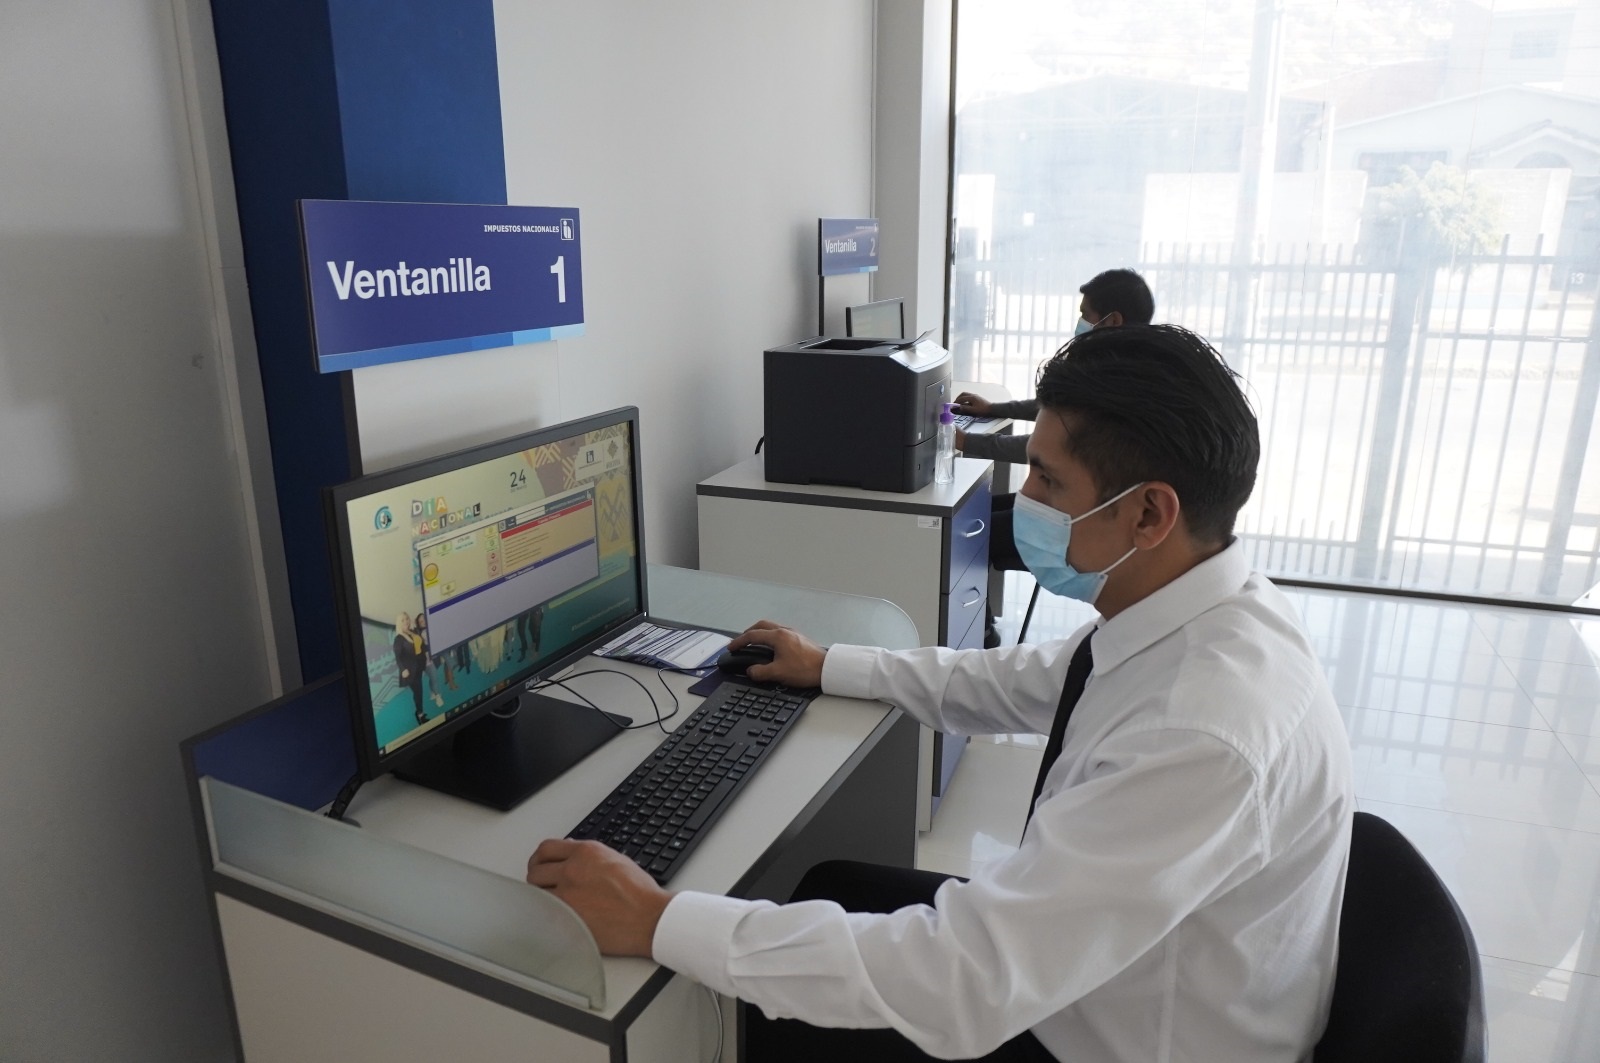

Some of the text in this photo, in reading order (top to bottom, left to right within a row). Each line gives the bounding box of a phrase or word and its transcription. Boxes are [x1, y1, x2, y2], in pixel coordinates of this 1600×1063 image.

[483, 224, 521, 233] IMPUESTOS
[522, 225, 560, 233] NACIONALES
[825, 237, 876, 257] Ventanilla 2
[326, 255, 566, 303] Ventanilla 1
[509, 468, 527, 488] 24
[411, 503, 481, 537] NACIONAL
[525, 675, 542, 690] DELL
